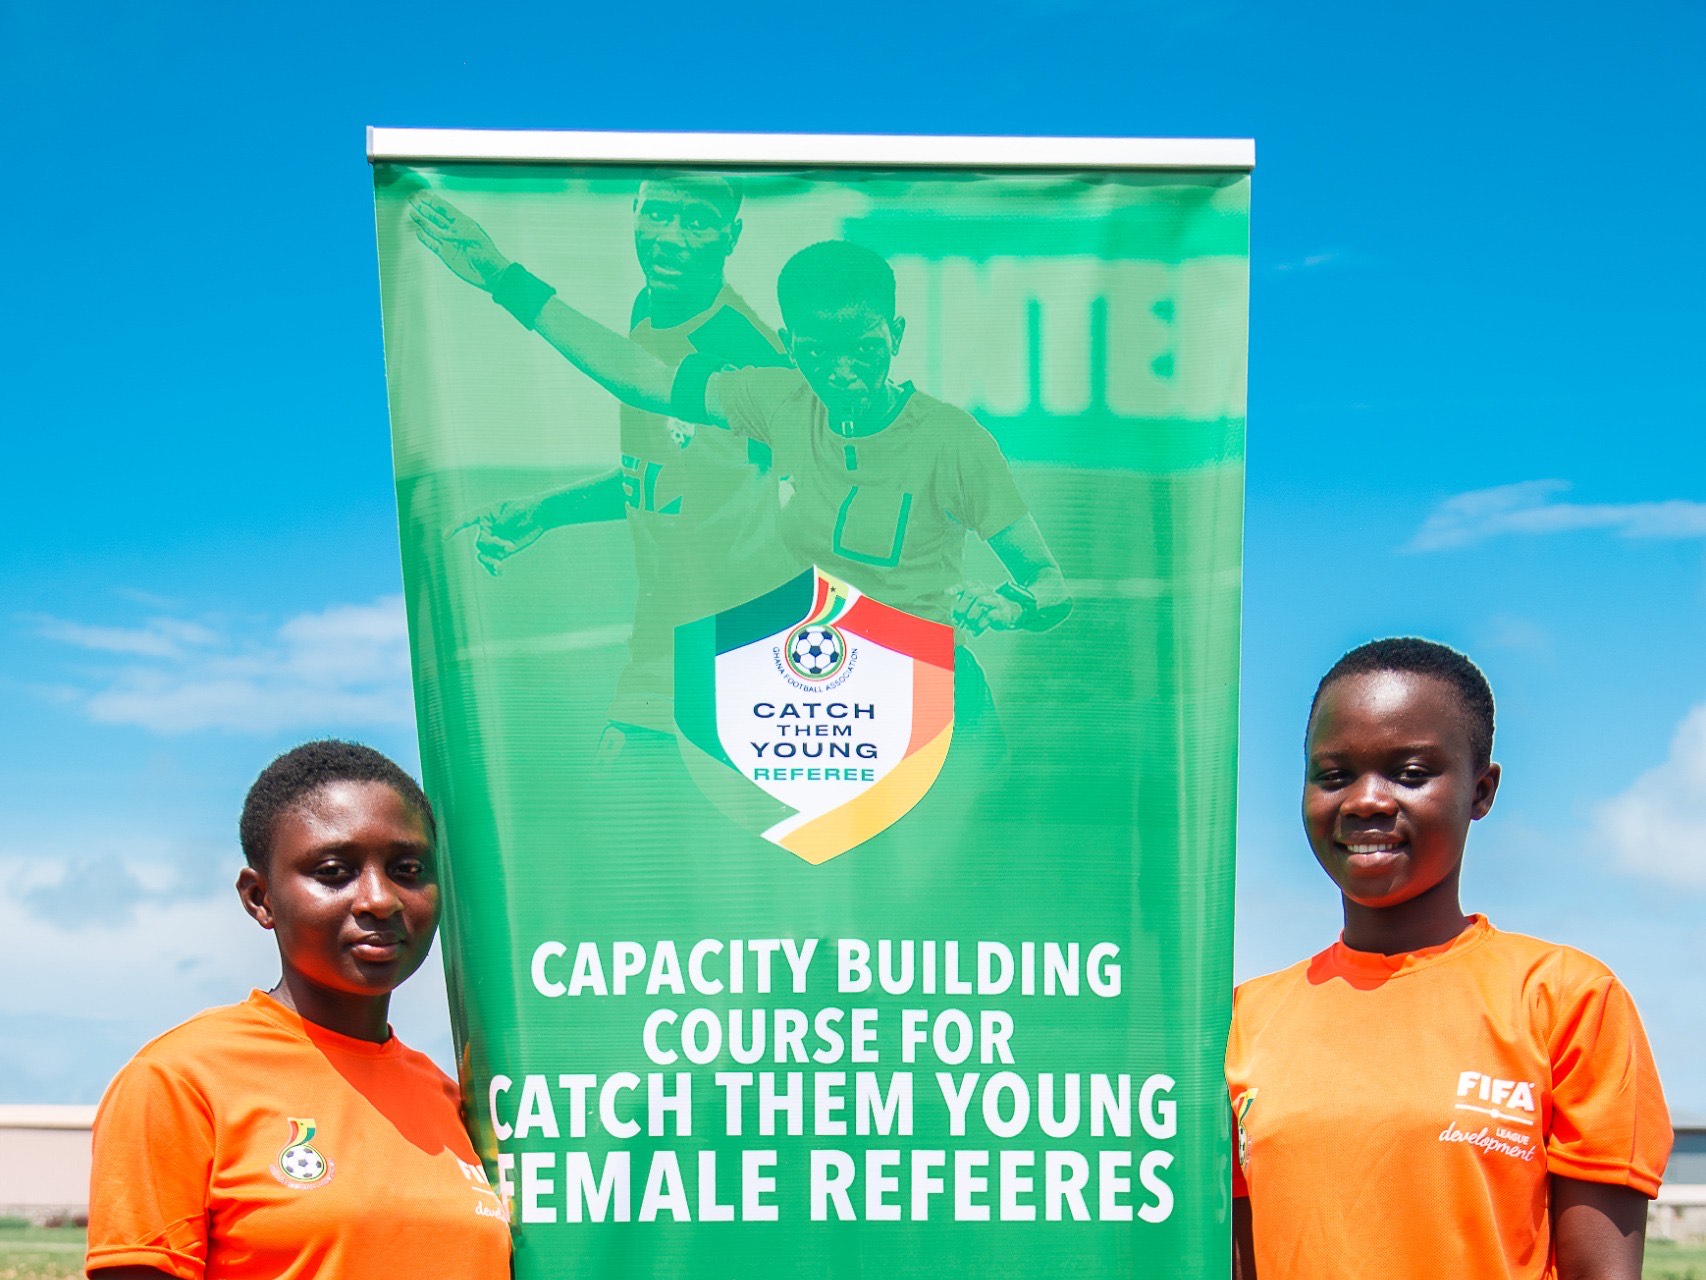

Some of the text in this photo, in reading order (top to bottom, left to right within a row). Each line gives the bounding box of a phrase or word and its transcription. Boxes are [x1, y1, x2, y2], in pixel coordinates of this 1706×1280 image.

[773, 646, 858, 693] GHANA FOOTBALL ASSOCIATION
[753, 702, 875, 720] CATCH
[776, 724, 852, 737] THEM
[750, 742, 878, 759] YOUNG
[753, 767, 875, 782] REFEREE
[530, 938, 1122, 998] CAPACITY BUILDING
[642, 1007, 1015, 1066] COURSE FOR
[488, 1071, 1178, 1141] CATCH THEM YOUNG
[1456, 1071, 1535, 1111] FIFA
[1438, 1120, 1536, 1162] development
[1496, 1127, 1530, 1145] LEAGUE
[497, 1149, 779, 1224] FEMALE
[810, 1149, 1174, 1223] REFEERES
